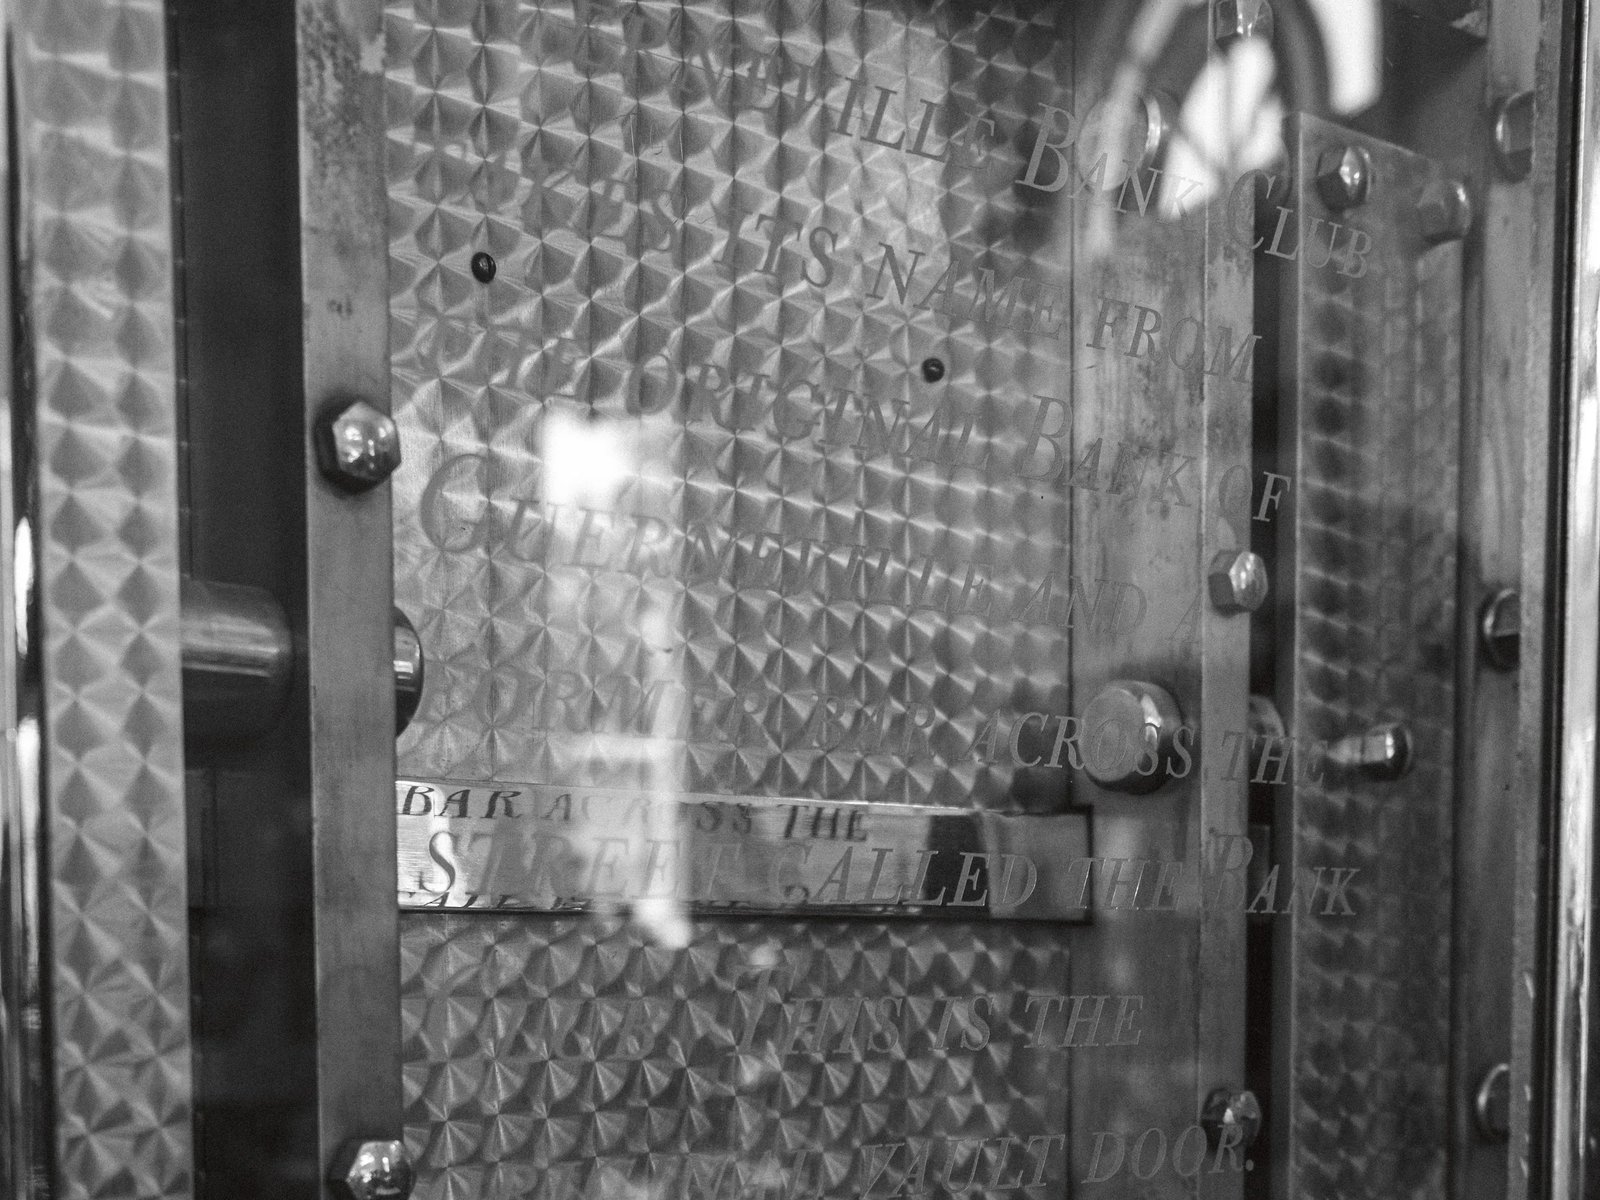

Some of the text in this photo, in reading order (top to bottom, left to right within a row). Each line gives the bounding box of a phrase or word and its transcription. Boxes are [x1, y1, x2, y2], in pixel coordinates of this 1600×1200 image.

[1015, 102, 1204, 226] BANK
[1227, 169, 1373, 279] CLUB
[714, 208, 838, 289] ITS
[866, 242, 1066, 341] NAME
[1086, 301, 1262, 385] FROM
[627, 352, 990, 470] ORIGINAL
[1015, 394, 1197, 507] BANK
[1218, 464, 1292, 523] OF
[1012, 570, 1147, 636] AND
[960, 708, 1195, 778] ACROSS
[1220, 730, 1330, 787] THE
[402, 785, 522, 819] BAR
[419, 830, 1361, 916] STREET CALLED THE BANK
[730, 965, 900, 1056] THIS
[927, 996, 996, 1053] IS
[1021, 994, 1146, 1049] THE
[859, 1133, 1067, 1200] VAULT
[1080, 1123, 1256, 1186] DOOR.
